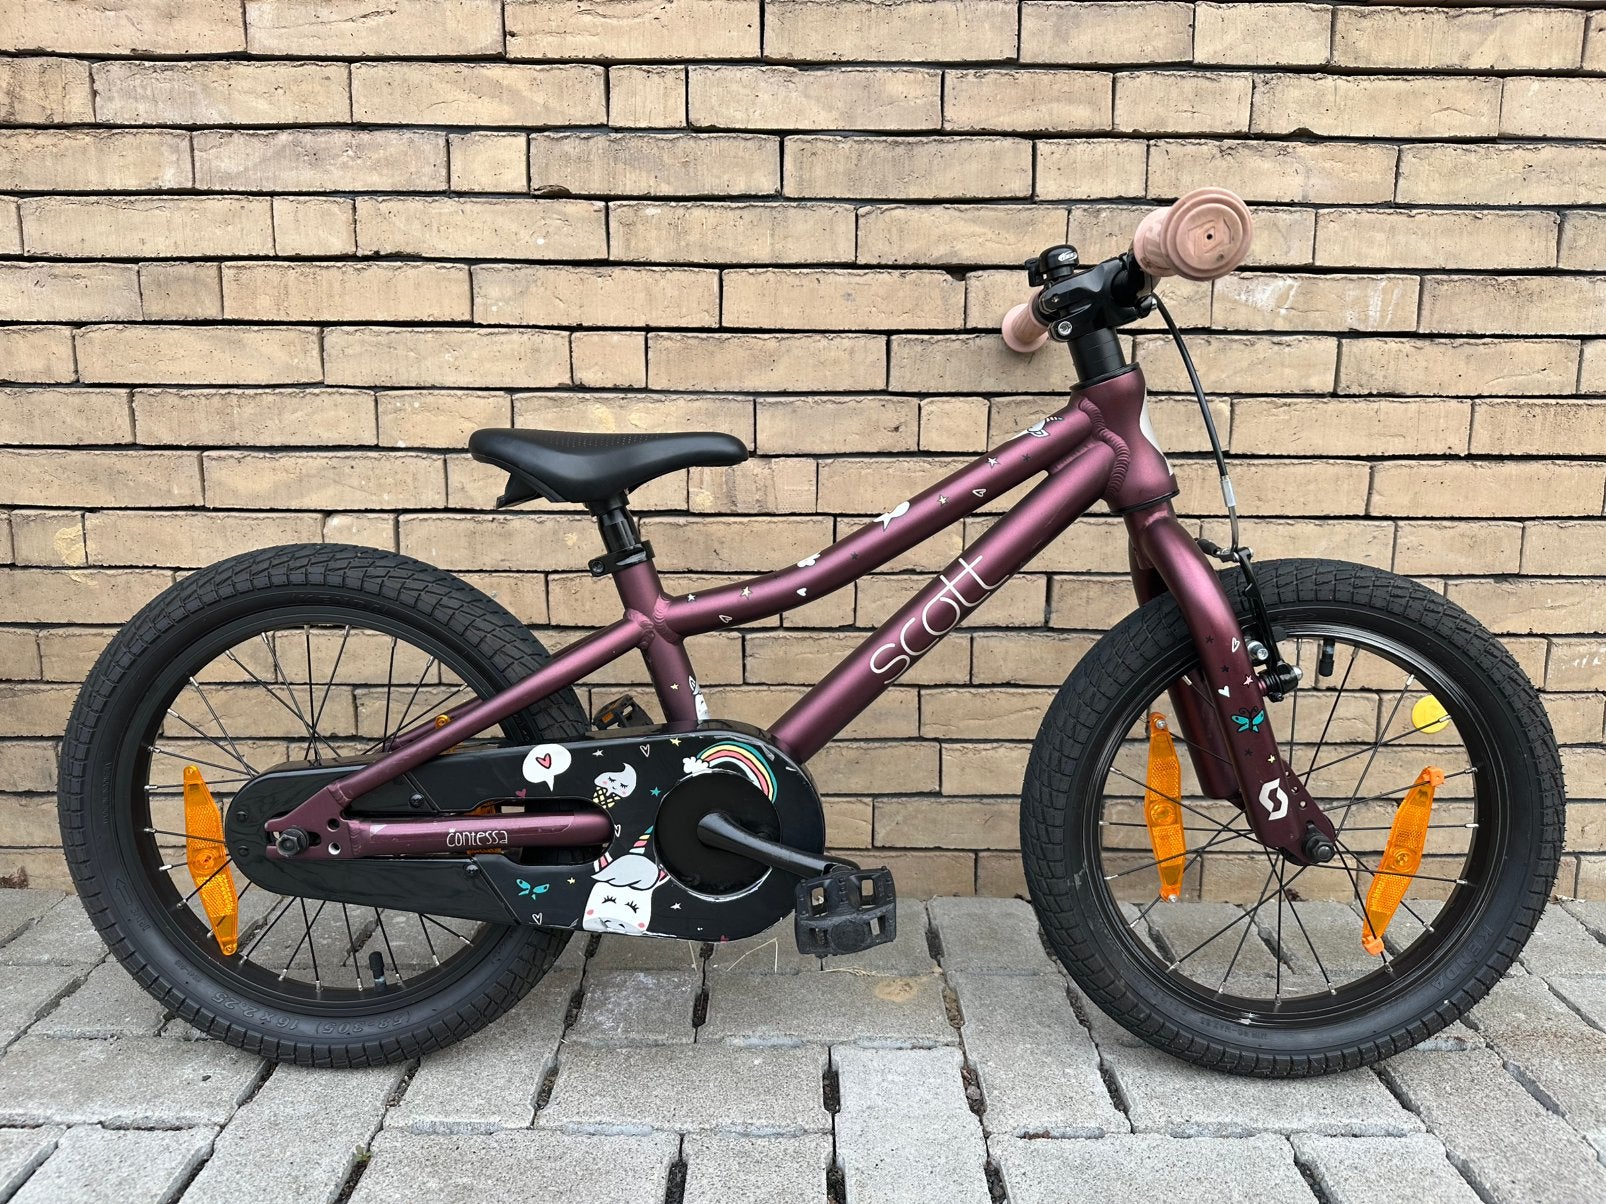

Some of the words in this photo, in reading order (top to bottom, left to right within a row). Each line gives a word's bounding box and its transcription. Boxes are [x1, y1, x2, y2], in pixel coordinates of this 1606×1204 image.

[1430, 924, 1495, 991] KENDA
[211, 991, 256, 1018] 2.25
[275, 1016, 298, 1032] 16
